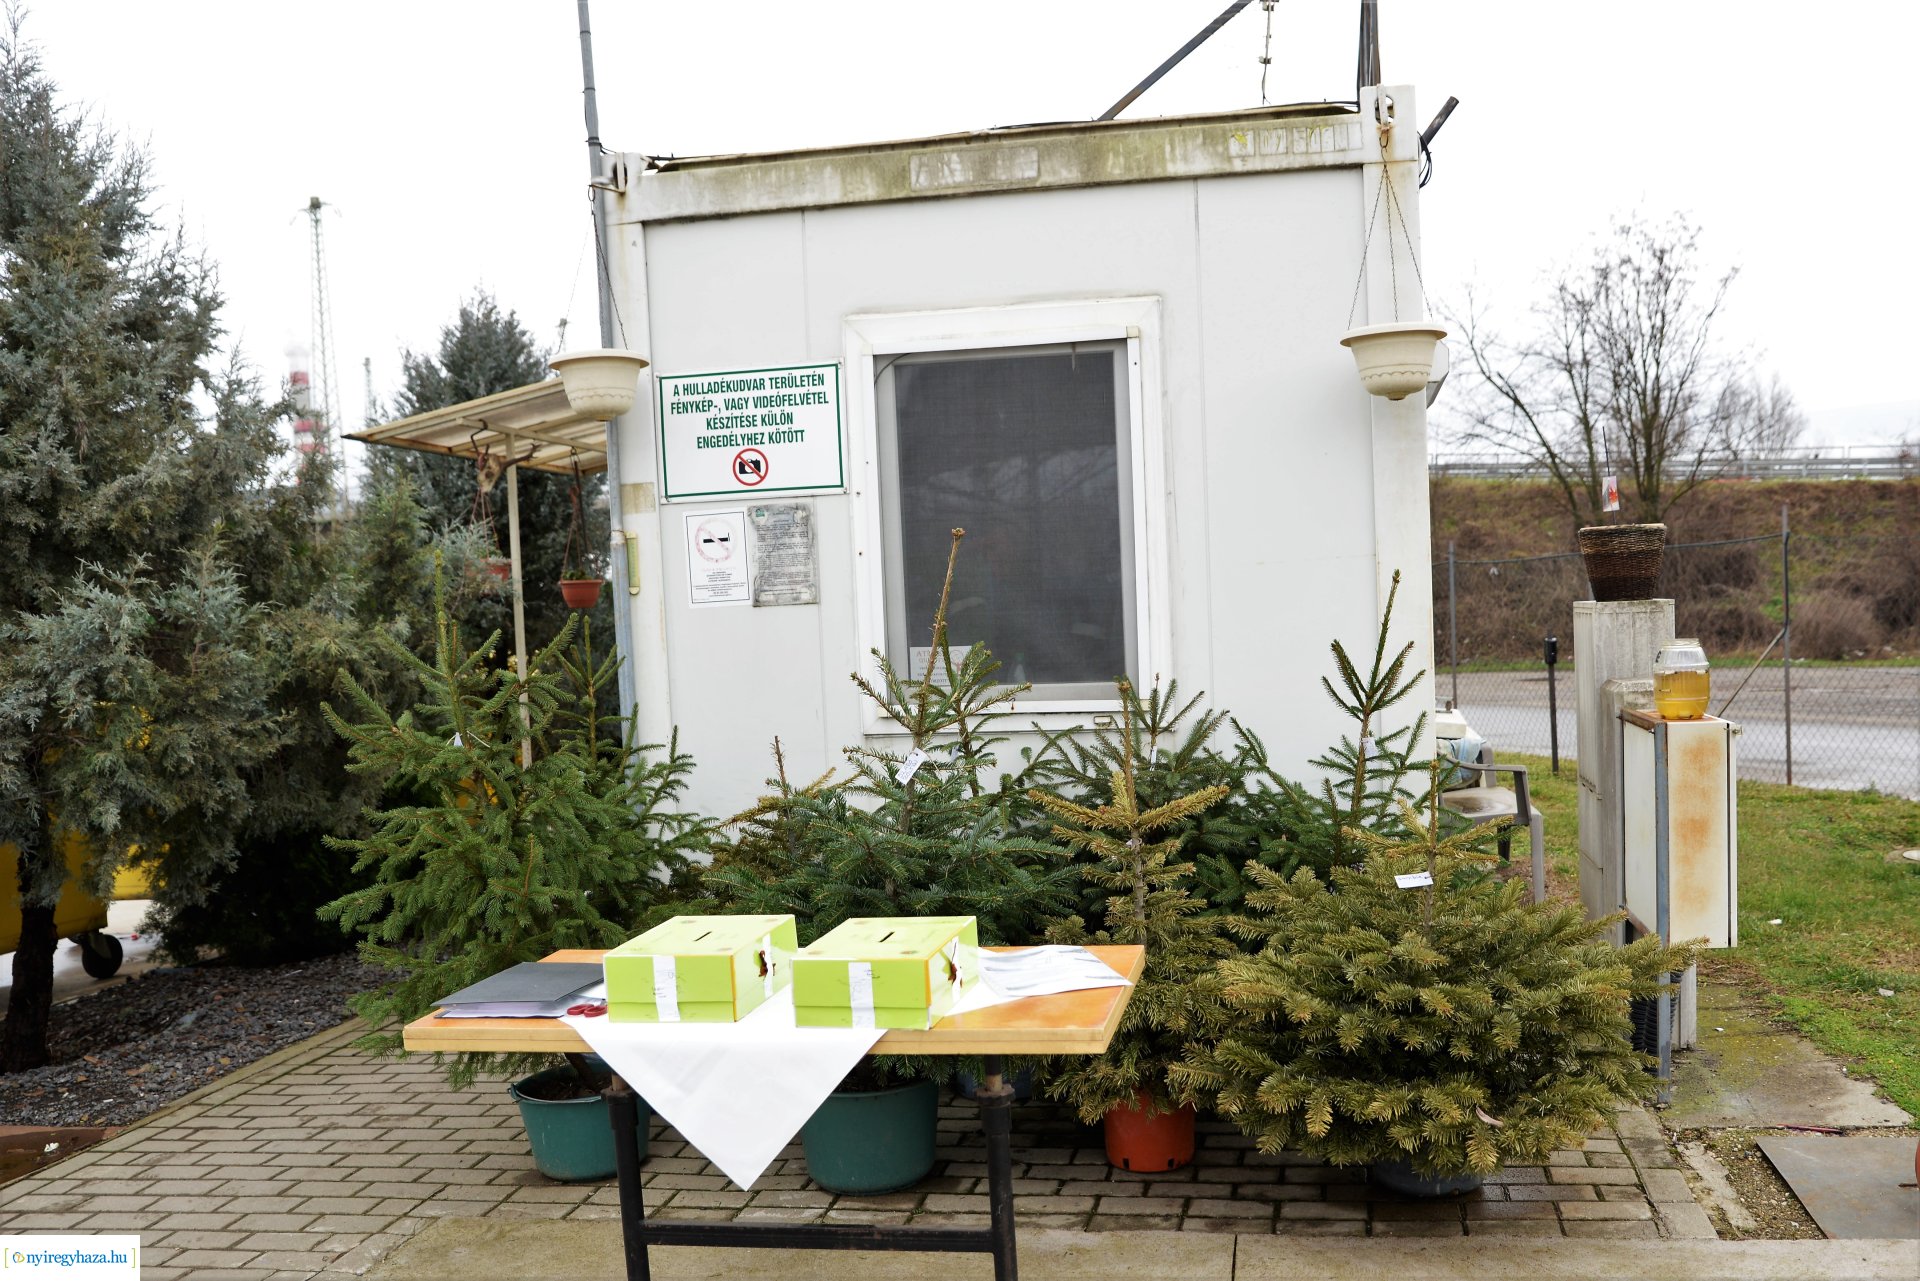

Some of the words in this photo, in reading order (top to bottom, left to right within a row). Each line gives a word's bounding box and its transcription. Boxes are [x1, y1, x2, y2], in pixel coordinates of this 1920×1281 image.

[673, 385, 680, 397] A
[683, 378, 765, 396] HULLADÉKUDVAR
[769, 371, 825, 389] TERÜLETÉN
[671, 397, 721, 414] FÉNYKÉP-,
[724, 398, 749, 411] VAGY
[753, 390, 829, 408] VIDEÓFELVÉTEL
[706, 412, 758, 430] KÉSZÍTÉSE
[761, 410, 793, 427] KÜLÖN
[697, 431, 765, 449] ENGEDÉLYHEZ
[768, 428, 805, 445] KÖTÖTT
